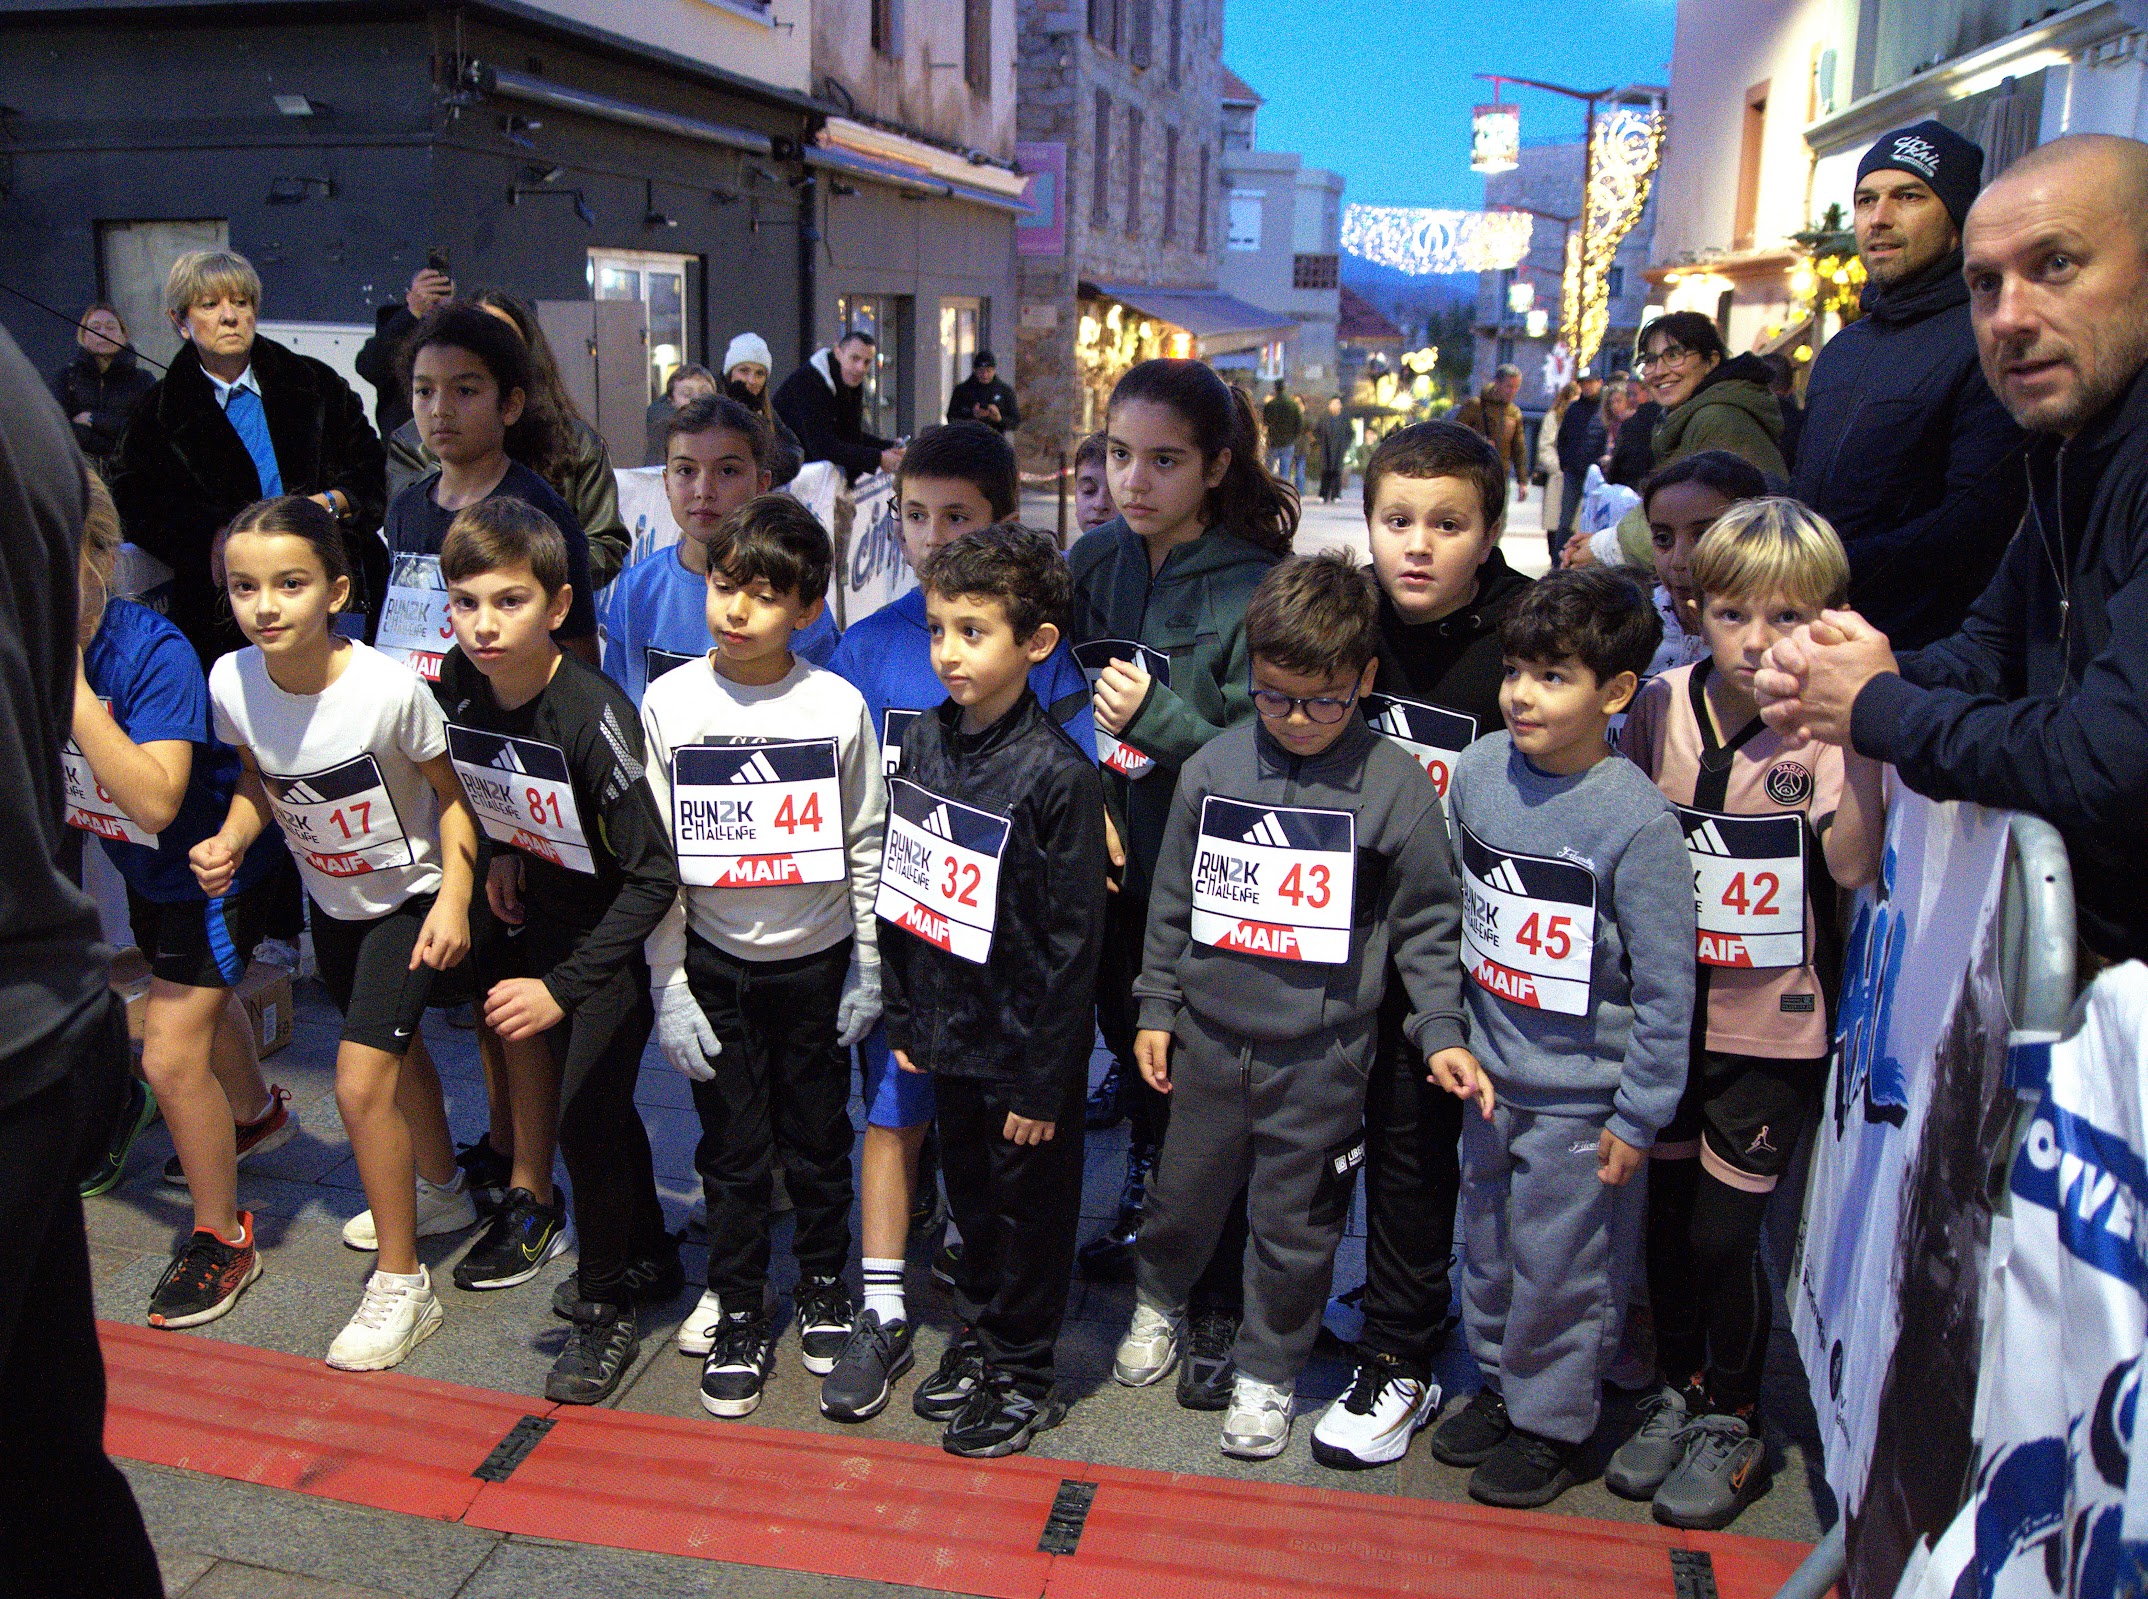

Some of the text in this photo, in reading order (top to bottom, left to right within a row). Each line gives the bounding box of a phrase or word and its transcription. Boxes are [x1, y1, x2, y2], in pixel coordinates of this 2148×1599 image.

[439, 602, 455, 639] 3
[1776, 764, 1806, 778] PARIS
[461, 772, 564, 829] RUN2K 81
[471, 793, 522, 820] CHALLENGE
[680, 792, 823, 834] RUN2K 44
[72, 811, 123, 837] MAIF
[329, 800, 371, 840] 17
[681, 814, 757, 841] CHALLENGE
[308, 855, 364, 873] MAIF
[515, 831, 561, 862] MAIF
[728, 858, 797, 883] MAIF
[887, 855, 931, 891] CHALLENGE
[889, 828, 982, 908] RUN2K 32
[1197, 850, 1332, 909] RUN2K 43
[1194, 872, 1261, 905] CHALLENGE
[1721, 871, 1780, 916] 42
[905, 907, 949, 944] MAIF
[1229, 924, 1297, 954] MAIF
[1515, 911, 1573, 961] 45
[1697, 935, 1746, 962] AIF
[1478, 962, 1535, 1000] MAIF
